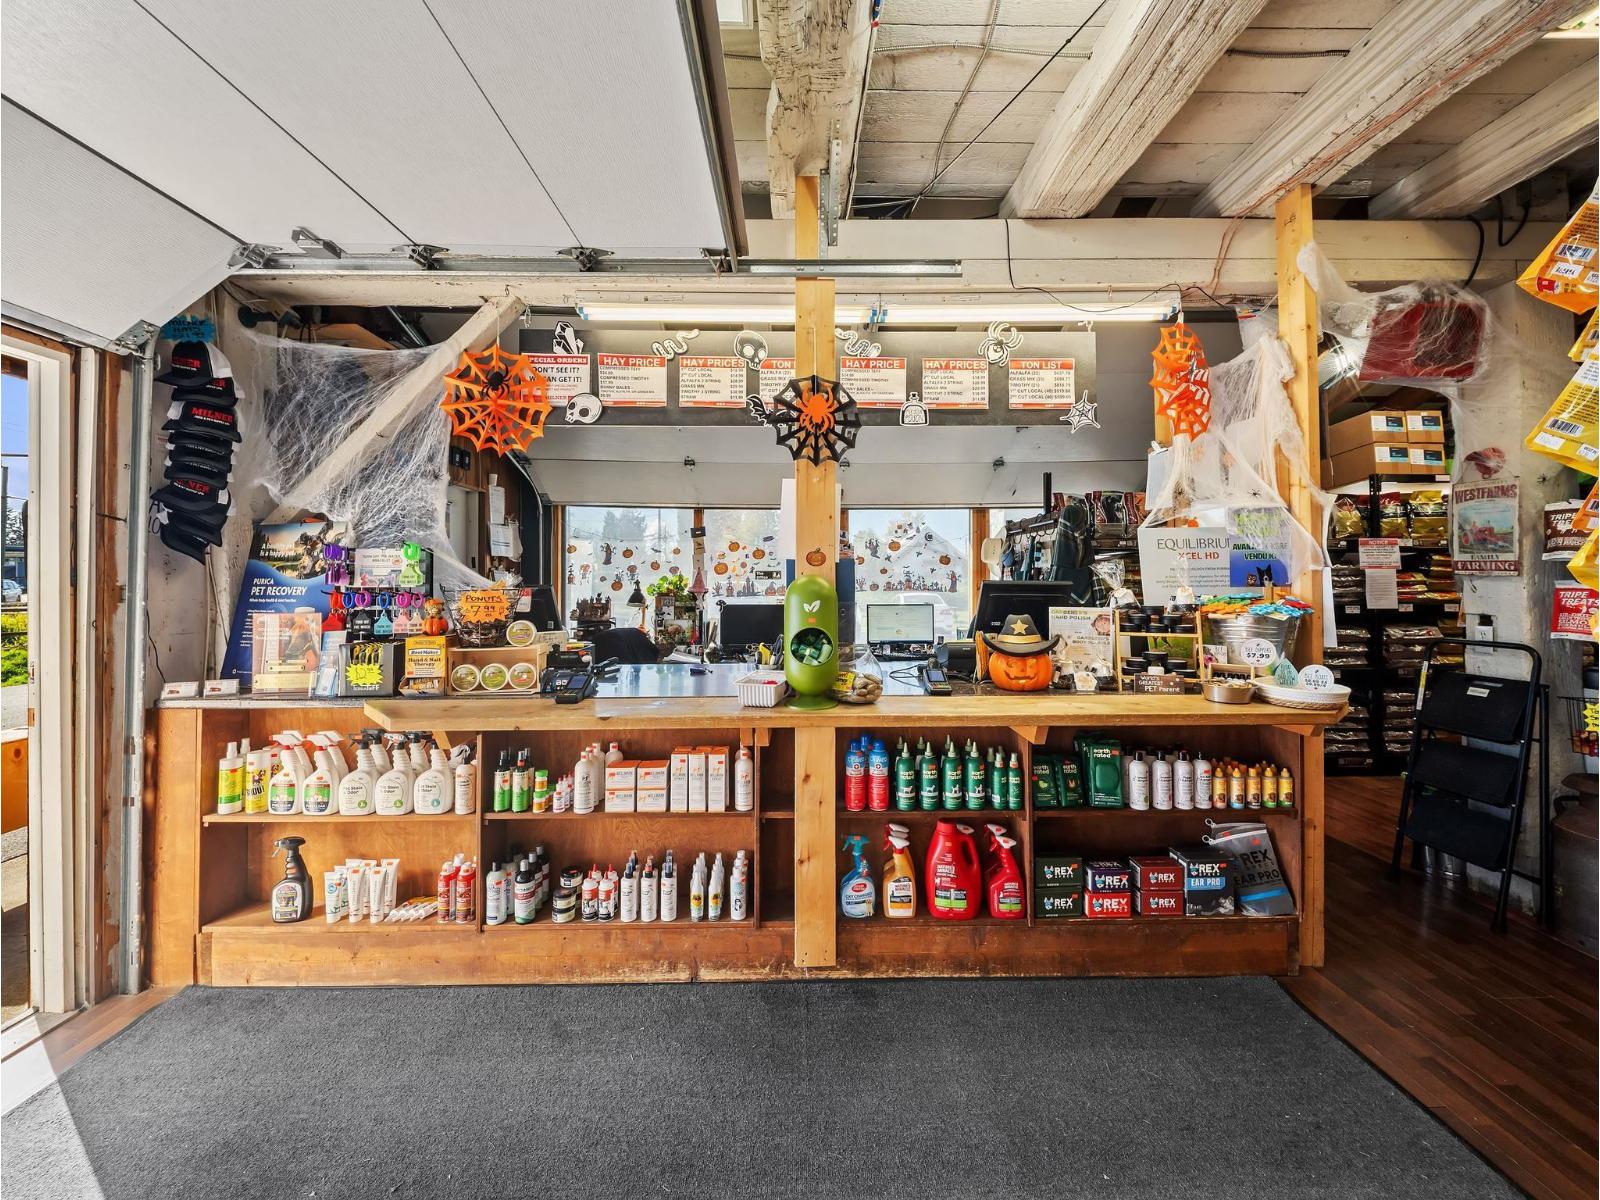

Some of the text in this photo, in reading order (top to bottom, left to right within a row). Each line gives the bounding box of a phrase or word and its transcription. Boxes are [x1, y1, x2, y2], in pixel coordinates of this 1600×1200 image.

[603, 356, 661, 367] HAY PRICE
[683, 358, 744, 368] HAY PRICES
[846, 359, 900, 369] HAY PRICE
[926, 360, 987, 369] HAY PRICES
[1021, 360, 1062, 369] TON LIST
[191, 407, 234, 423] MILNER
[1455, 484, 1518, 504] WESTFARMS
[1551, 512, 1577, 521] TRIPE
[1157, 538, 1230, 551] EQUILIBRIU
[1178, 552, 1202, 560] XCEL
[1244, 552, 1268, 560] VENDU
[1457, 561, 1514, 570] FARMING
[251, 587, 308, 596] PET RECOVERY
[1246, 652, 1270, 660] $7.99
[1243, 849, 1272, 866] REX
[1054, 867, 1074, 875] REX
[1199, 863, 1220, 873] REX
[1257, 869, 1280, 880] PRO
[1105, 875, 1129, 886] REX
[1191, 878, 1221, 886] EAR PRO
[1054, 898, 1073, 906] REX
[1103, 898, 1128, 909] REX
[1158, 898, 1176, 906] REX
